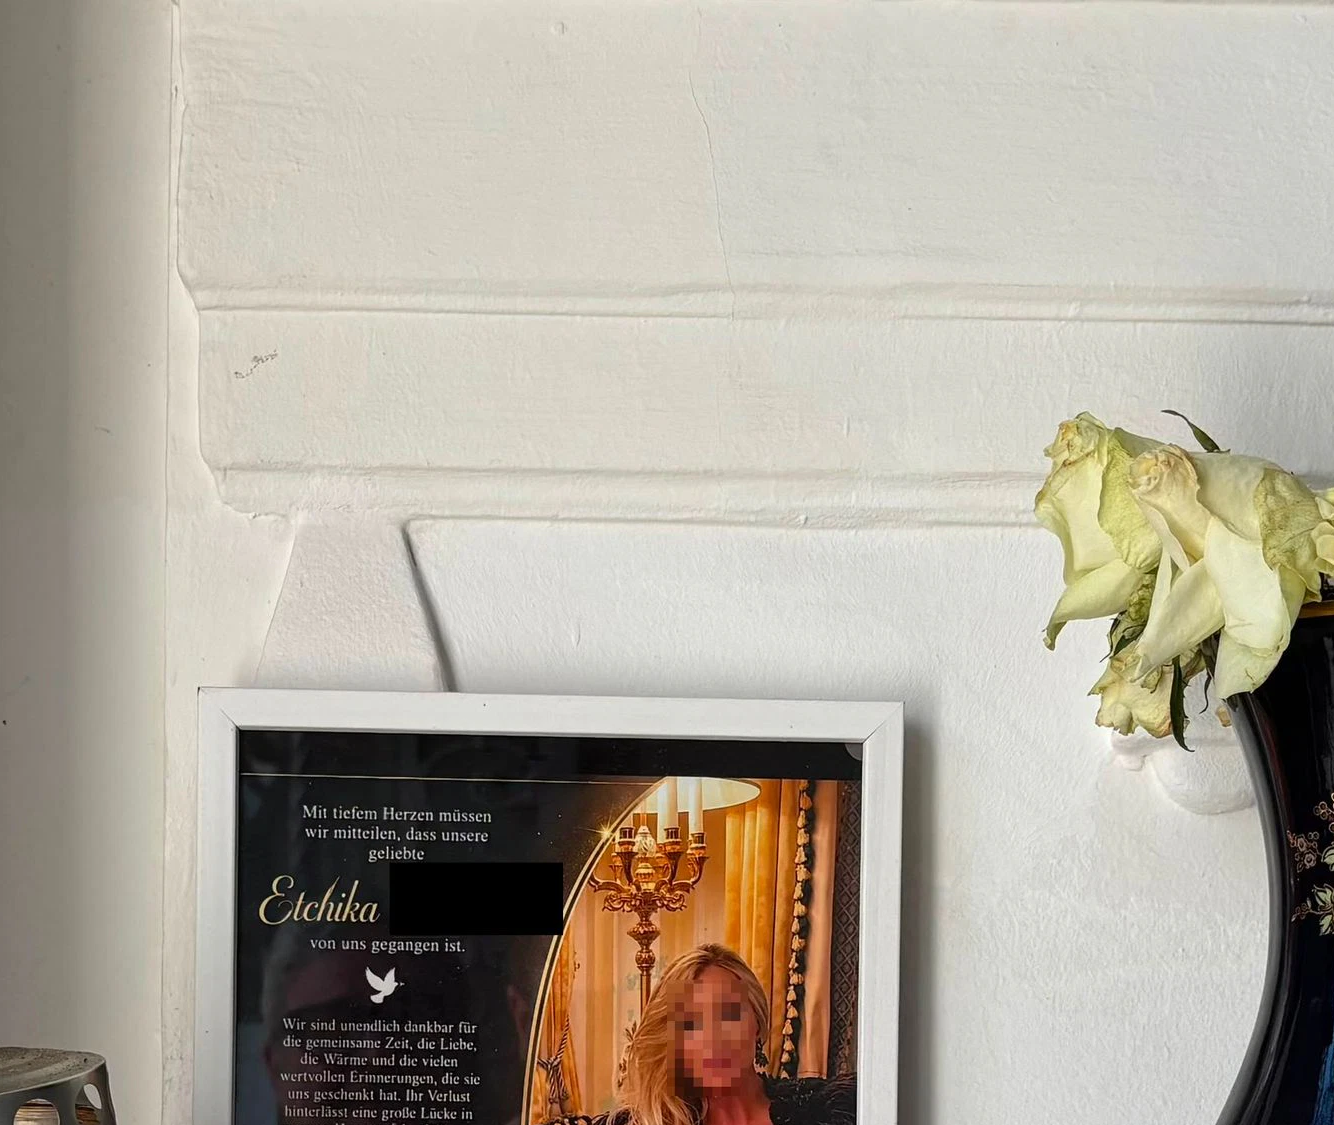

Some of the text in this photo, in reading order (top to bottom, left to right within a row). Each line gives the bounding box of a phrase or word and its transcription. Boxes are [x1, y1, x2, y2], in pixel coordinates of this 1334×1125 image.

[303, 805, 491, 823] Mit tiefem Herzen müssen
[305, 827, 488, 842] wir mitteilen, dass unsere
[368, 847, 424, 862] geliebte
[258, 876, 380, 925] Etchika
[311, 939, 465, 954] von uns gegangen ist.
[283, 1018, 478, 1033] Wir sind unendlich dankbar für
[283, 1036, 477, 1051] die gemeinsame Zeit, die Liebe,
[301, 1053, 458, 1067] die Wärme und die vielen
[281, 1070, 480, 1086] wertvollen Erinnerungen, die sie
[288, 1089, 470, 1102] uns geschenkt hat. Ihr Verlust
[285, 1105, 473, 1121] hinterlässt eine große Lücke in
